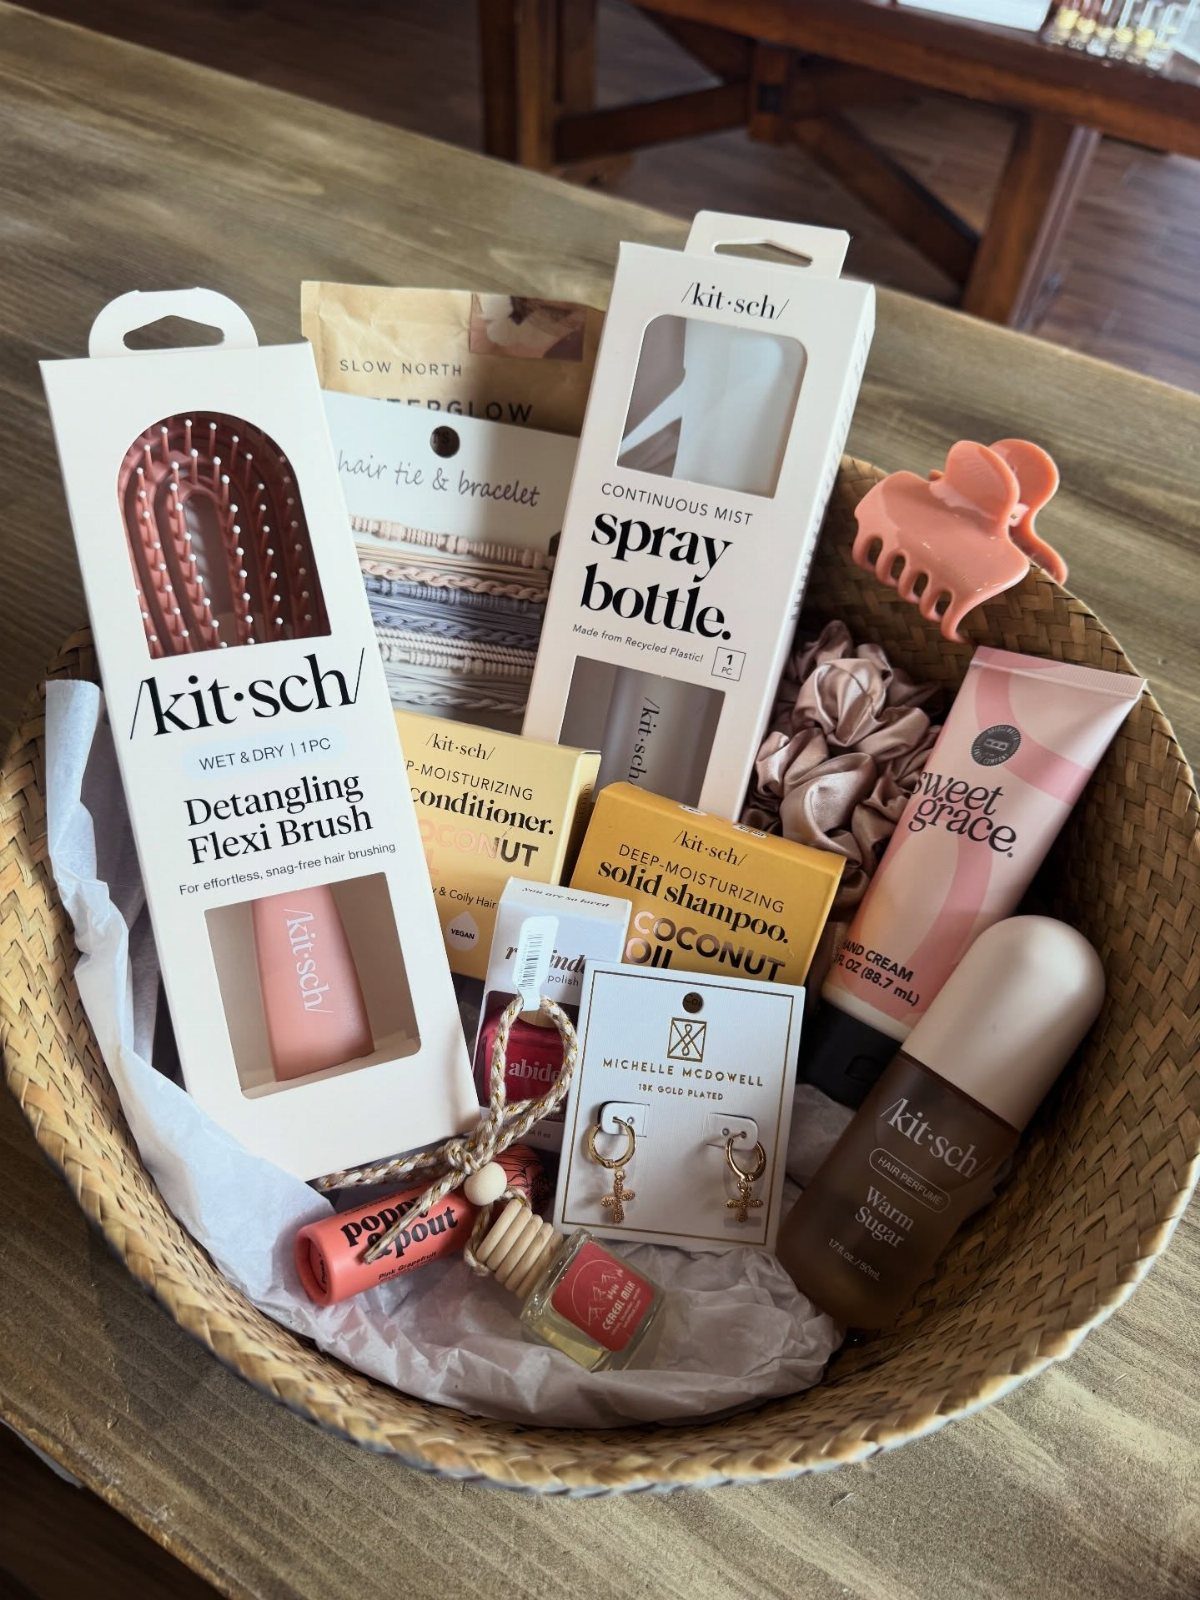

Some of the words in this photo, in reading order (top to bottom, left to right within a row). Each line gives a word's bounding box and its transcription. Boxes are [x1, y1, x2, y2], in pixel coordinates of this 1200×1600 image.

[339, 359, 391, 374] SLOW
[402, 362, 462, 376] NORTH
[337, 450, 388, 480] hair
[395, 461, 424, 486] tie
[432, 468, 449, 491] &
[458, 471, 541, 507] bracelet
[601, 482, 709, 516] CONTINUOUS
[714, 506, 754, 526] MIST
[590, 512, 733, 583] spray
[580, 563, 732, 641] bottle.
[572, 623, 599, 638] Made
[601, 629, 623, 644] from
[625, 636, 667, 656] Recycled
[670, 648, 705, 663] Plastic!
[726, 653, 733, 666] 1
[721, 666, 733, 676] PC
[199, 752, 235, 770] WET
[240, 751, 250, 764] &
[252, 745, 284, 762] DRY
[629, 696, 660, 784] /kit·sch
[184, 775, 364, 826] Detangling
[405, 760, 533, 801] P-MOISTURIZING
[912, 771, 1004, 816] sweet
[410, 787, 554, 835] conditioner.
[188, 823, 273, 865] Flexi
[277, 805, 374, 848] Brush
[418, 818, 539, 867] OCONUT
[179, 883, 200, 896] For
[203, 870, 263, 891] effortless,
[266, 858, 322, 879] snag-free
[324, 852, 345, 865] hair
[348, 842, 396, 860] brushing
[619, 844, 785, 914] DEEP-MOISTURIZING
[449, 889, 474, 905] Coily
[476, 896, 497, 910] Hair
[598, 861, 663, 897] solid
[664, 883, 789, 944] shampoo.
[451, 929, 475, 940] VEGAN
[634, 911, 785, 981] COCONUT
[548, 974, 579, 987] polish
[845, 958, 862, 974] OZ
[861, 966, 894, 989] (88.7
[893, 986, 920, 1007] mL)
[865, 950, 914, 982] CREAM
[603, 1057, 674, 1075] MICHELLE
[682, 1067, 764, 1087] MCDOWELL
[638, 1083, 653, 1093] 18K
[658, 1085, 684, 1096] GOLD
[687, 1089, 724, 1101] PLATED
[877, 1155, 900, 1177] HAIR
[900, 1172, 944, 1206] PERFUME
[340, 1197, 428, 1247] popp
[855, 1206, 904, 1248] Sugar
[866, 1185, 914, 1232] Warm
[394, 1206, 459, 1259] pout
